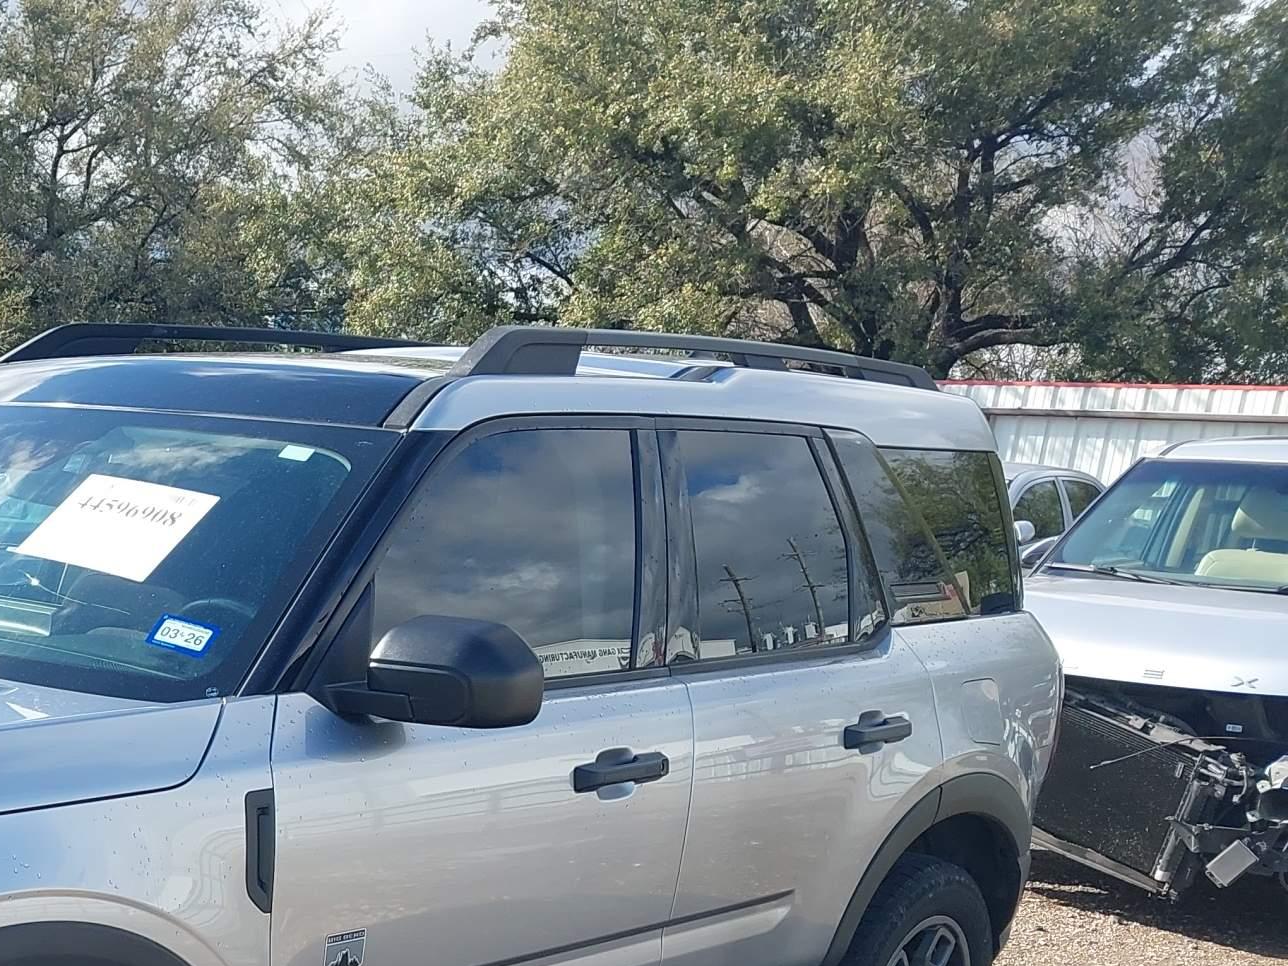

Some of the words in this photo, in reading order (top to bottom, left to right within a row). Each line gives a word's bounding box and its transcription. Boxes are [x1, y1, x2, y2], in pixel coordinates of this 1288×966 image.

[78, 496, 183, 527] 44596908
[160, 626, 180, 639] 03
[184, 632, 205, 646] 26
